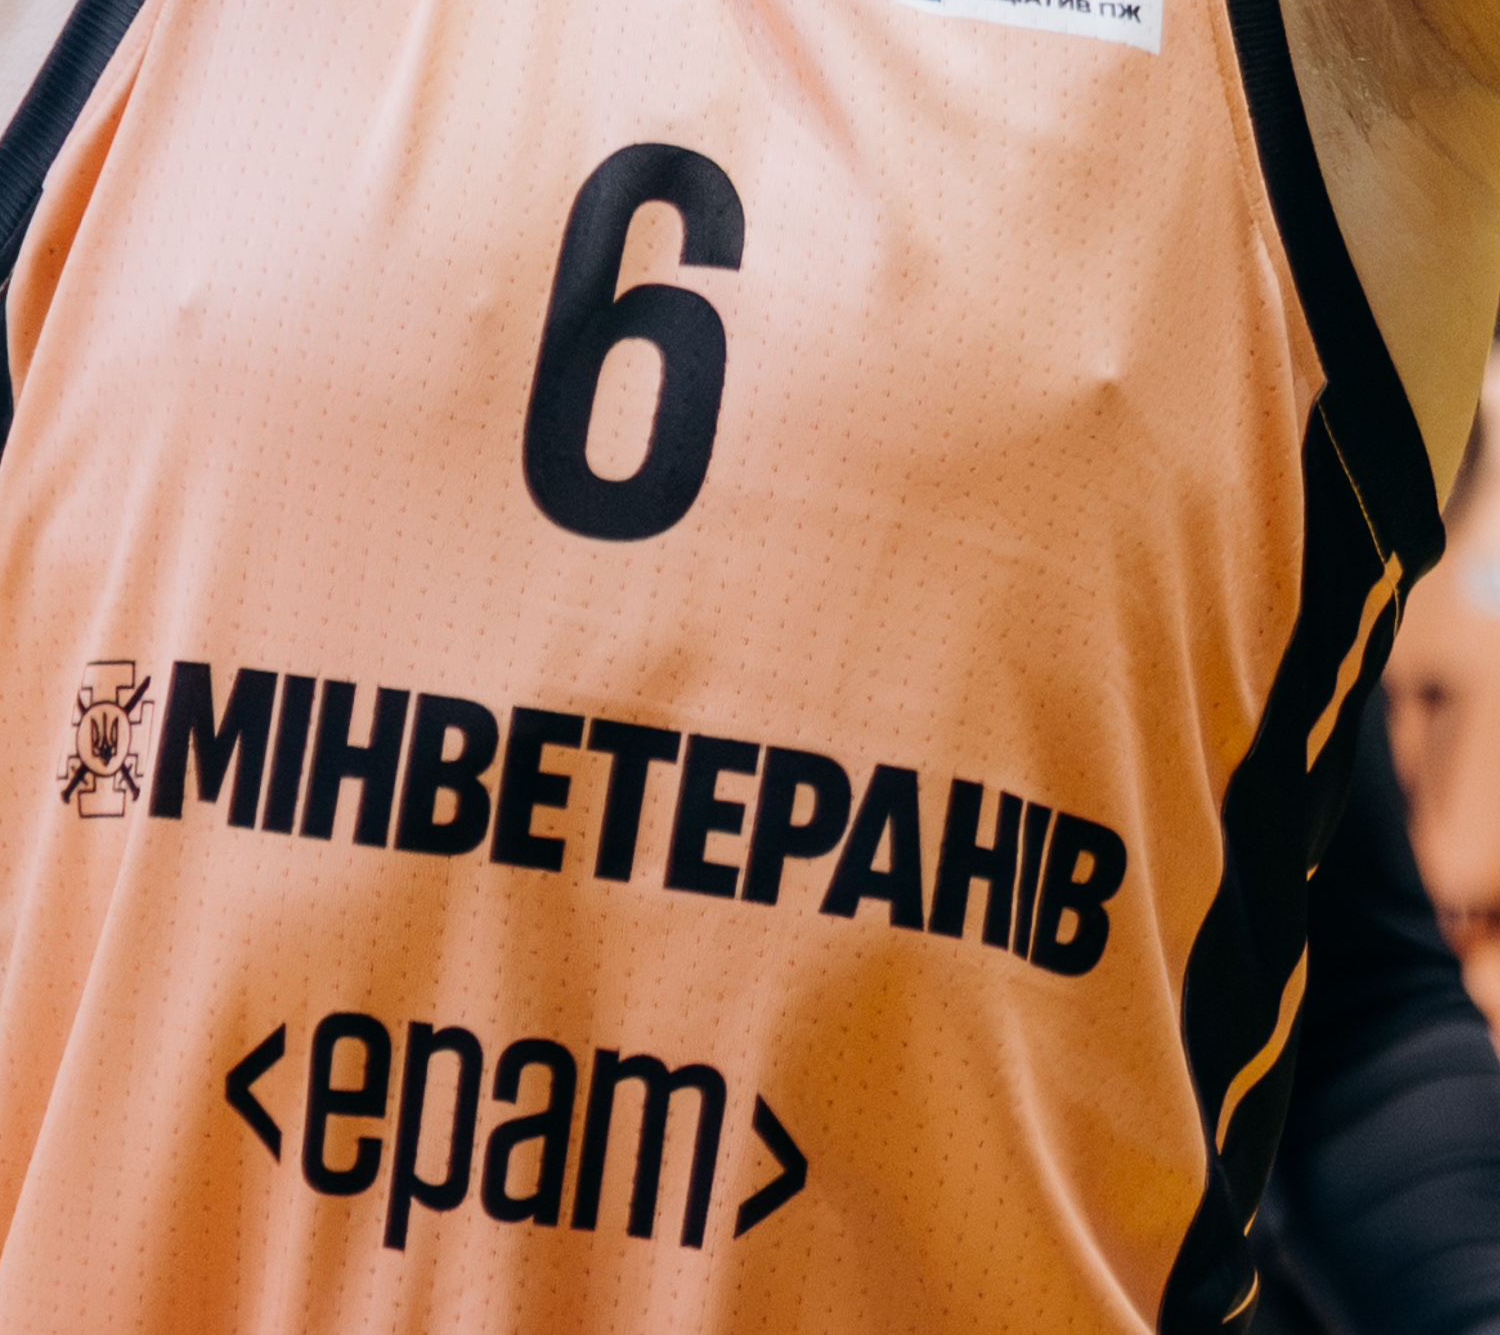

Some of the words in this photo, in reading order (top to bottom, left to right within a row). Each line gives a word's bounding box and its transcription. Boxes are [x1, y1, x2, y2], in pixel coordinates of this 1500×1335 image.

[1098, 2, 1143, 23] ПЖ
[521, 142, 746, 543] 6
[149, 661, 1129, 979] МІНВЕТЕРАНІВ
